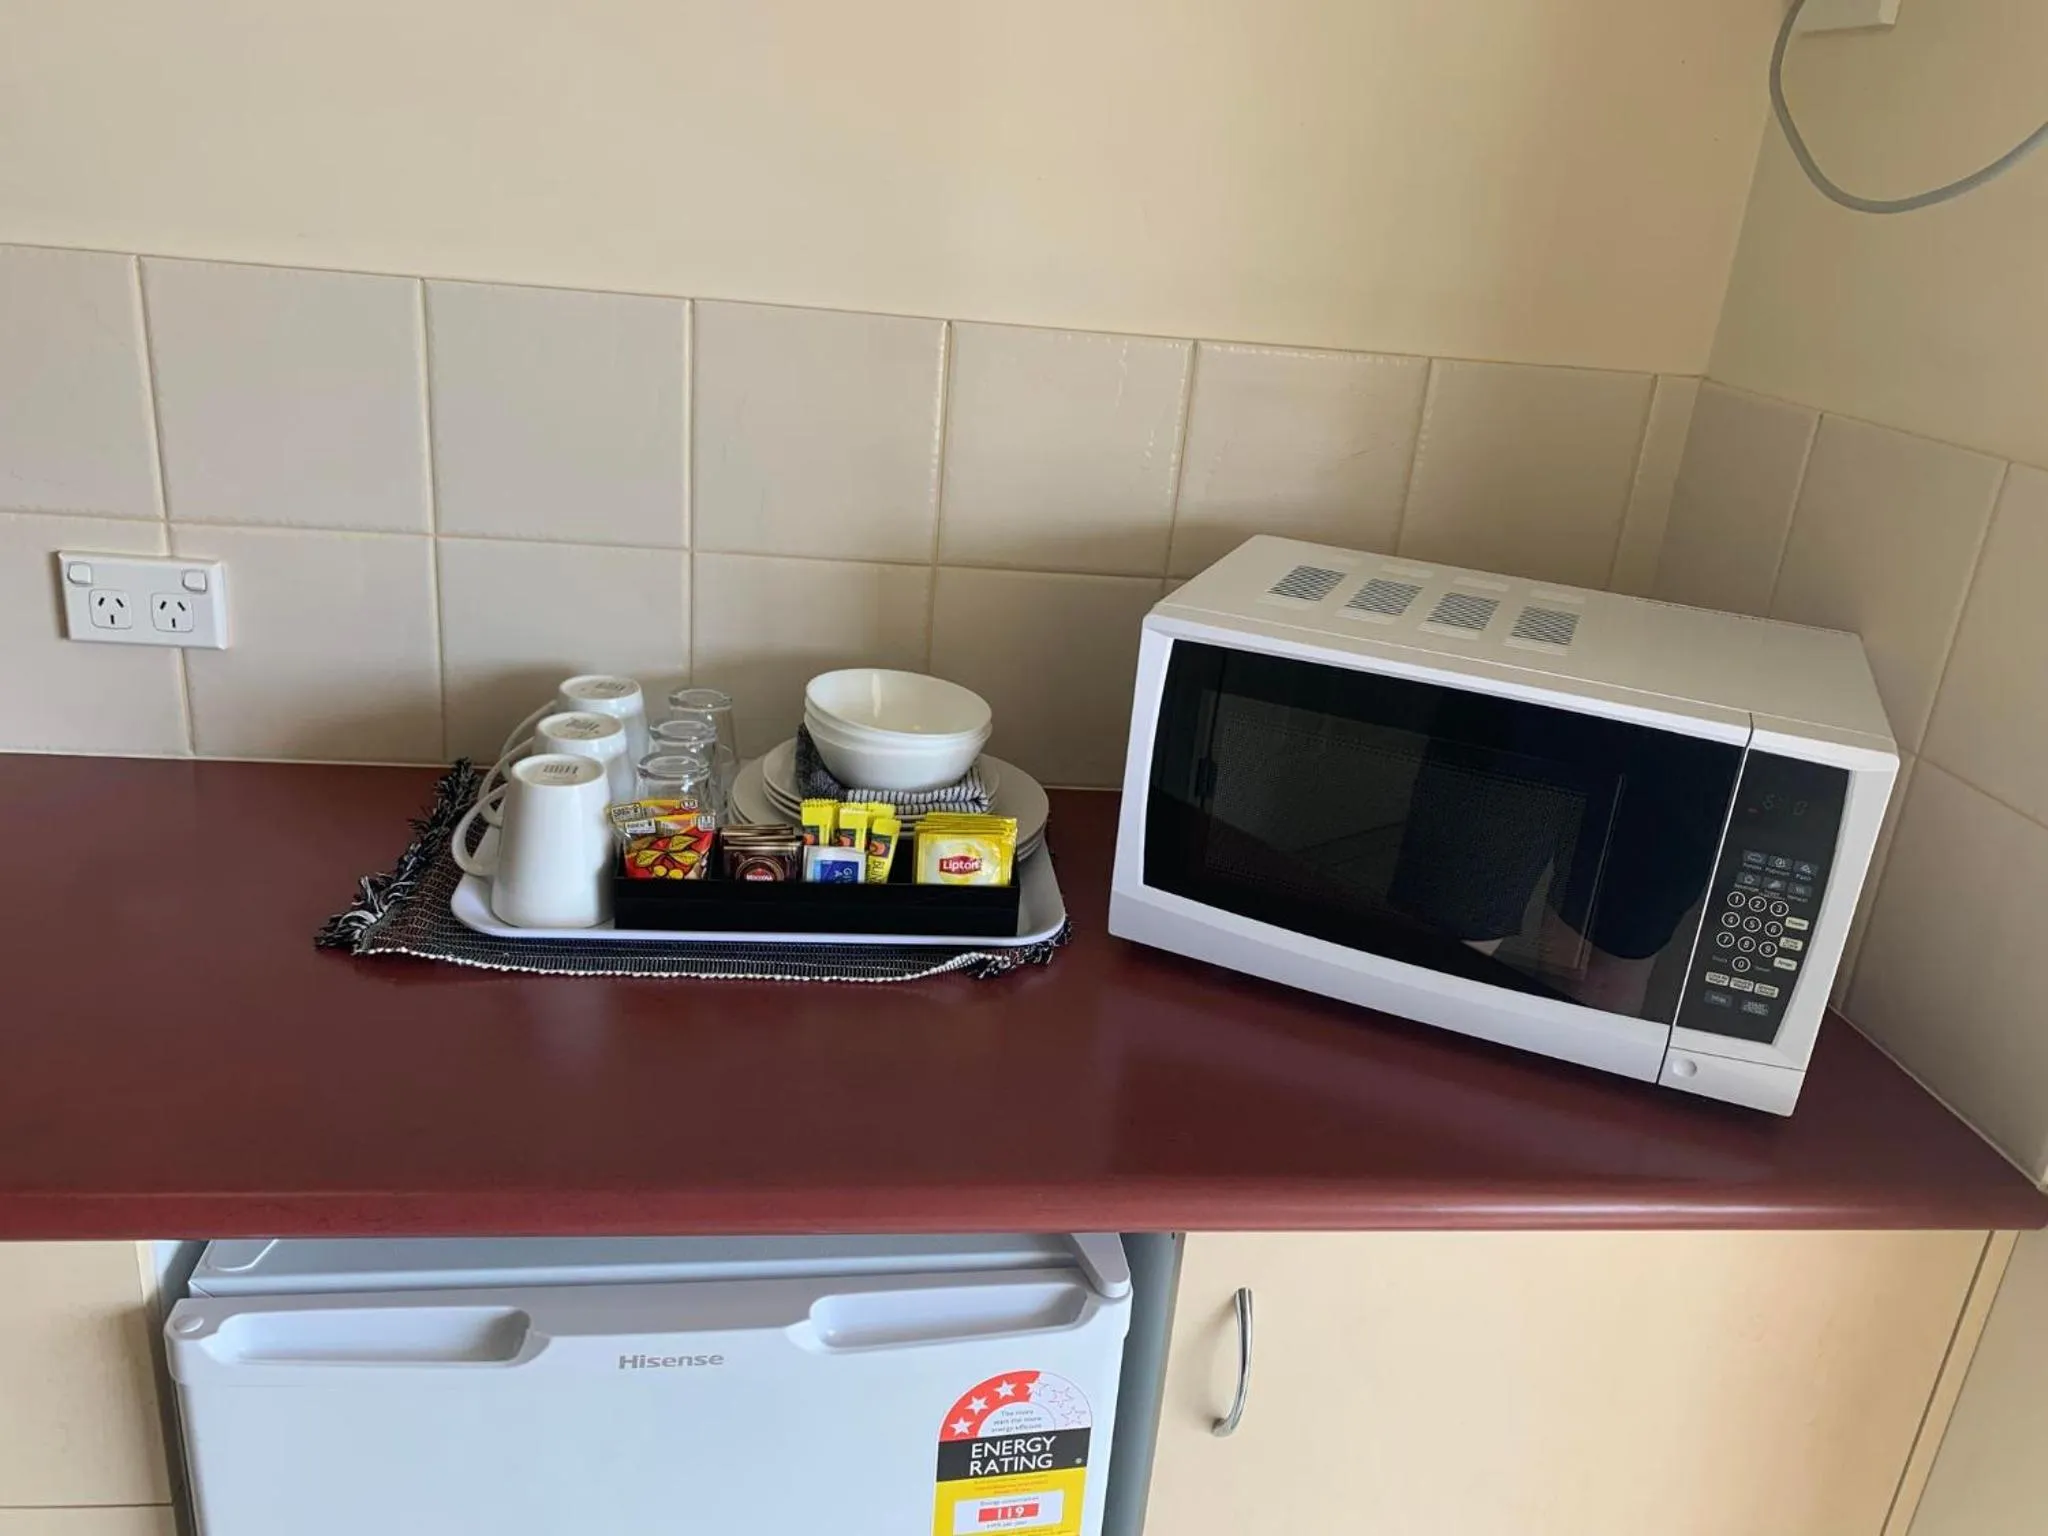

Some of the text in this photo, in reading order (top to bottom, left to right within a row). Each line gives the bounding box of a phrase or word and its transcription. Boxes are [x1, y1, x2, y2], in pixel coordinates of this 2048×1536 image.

[942, 859, 980, 872] Lipton
[618, 1353, 725, 1369] Hisense
[971, 1435, 1057, 1459] ENERGY
[969, 1453, 1054, 1476] RATING
[997, 1506, 1025, 1520] 119
